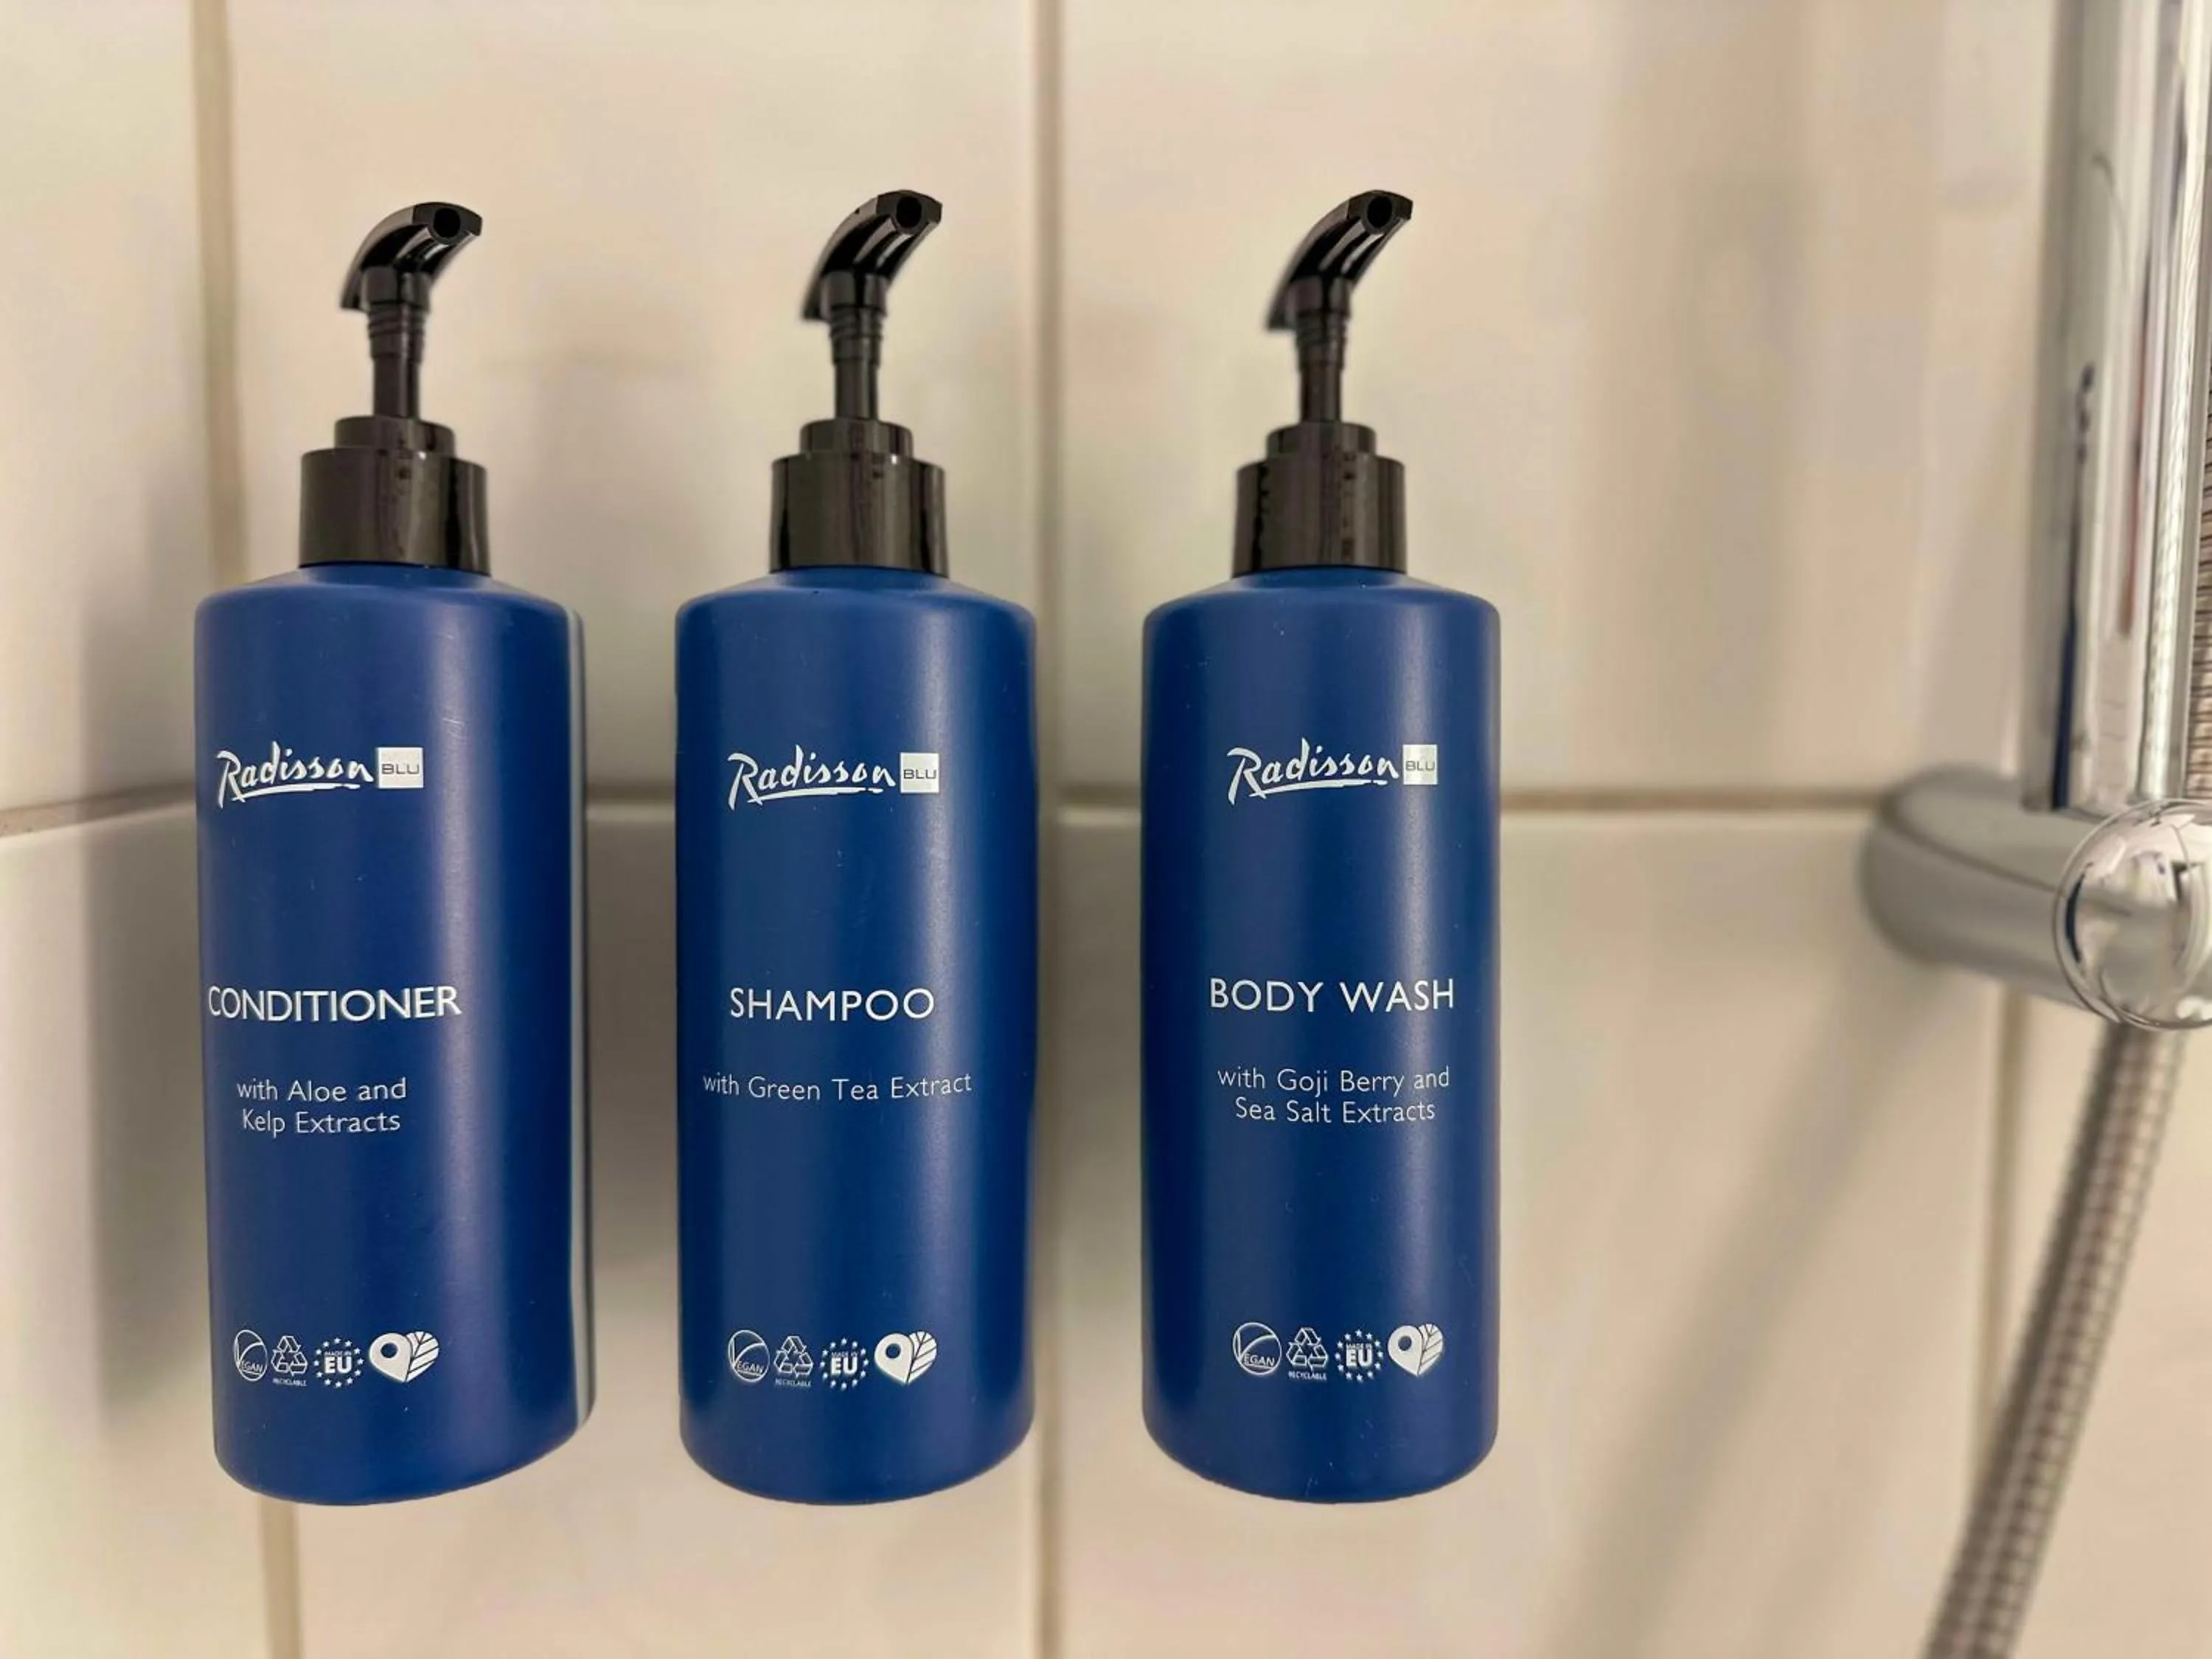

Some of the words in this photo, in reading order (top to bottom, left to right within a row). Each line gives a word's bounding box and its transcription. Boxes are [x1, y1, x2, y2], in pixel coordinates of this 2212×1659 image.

[216, 741, 375, 808] Radisson
[728, 745, 897, 810] Radisson
[1227, 737, 1399, 805] Radisson
[208, 985, 462, 1022] CONDITIONER
[729, 987, 935, 1022] SHAMPOO
[1210, 977, 1324, 1014] BODY
[1339, 977, 1454, 1014] WASH
[236, 1077, 278, 1102] with
[288, 1079, 347, 1103] Aloe
[357, 1077, 407, 1102] and
[702, 1072, 740, 1097] with
[748, 1076, 821, 1102] Green
[832, 1077, 880, 1101] Tea
[891, 1073, 973, 1100] Extract
[1217, 1065, 1266, 1090] with
[1276, 1067, 1328, 1097] Goji
[1340, 1068, 1405, 1097] Berry
[1413, 1065, 1450, 1090] and
[242, 1108, 286, 1139] Kelp
[295, 1110, 402, 1134] Extracts
[1235, 1096, 1276, 1122] Sea
[1286, 1099, 1332, 1124] Salt
[1342, 1099, 1436, 1124] Extracts
[324, 1356, 352, 1374] EU
[830, 1357, 858, 1376] EU
[1346, 1349, 1374, 1368] EU
[1287, 1370, 1327, 1381] RECYCLABLE
